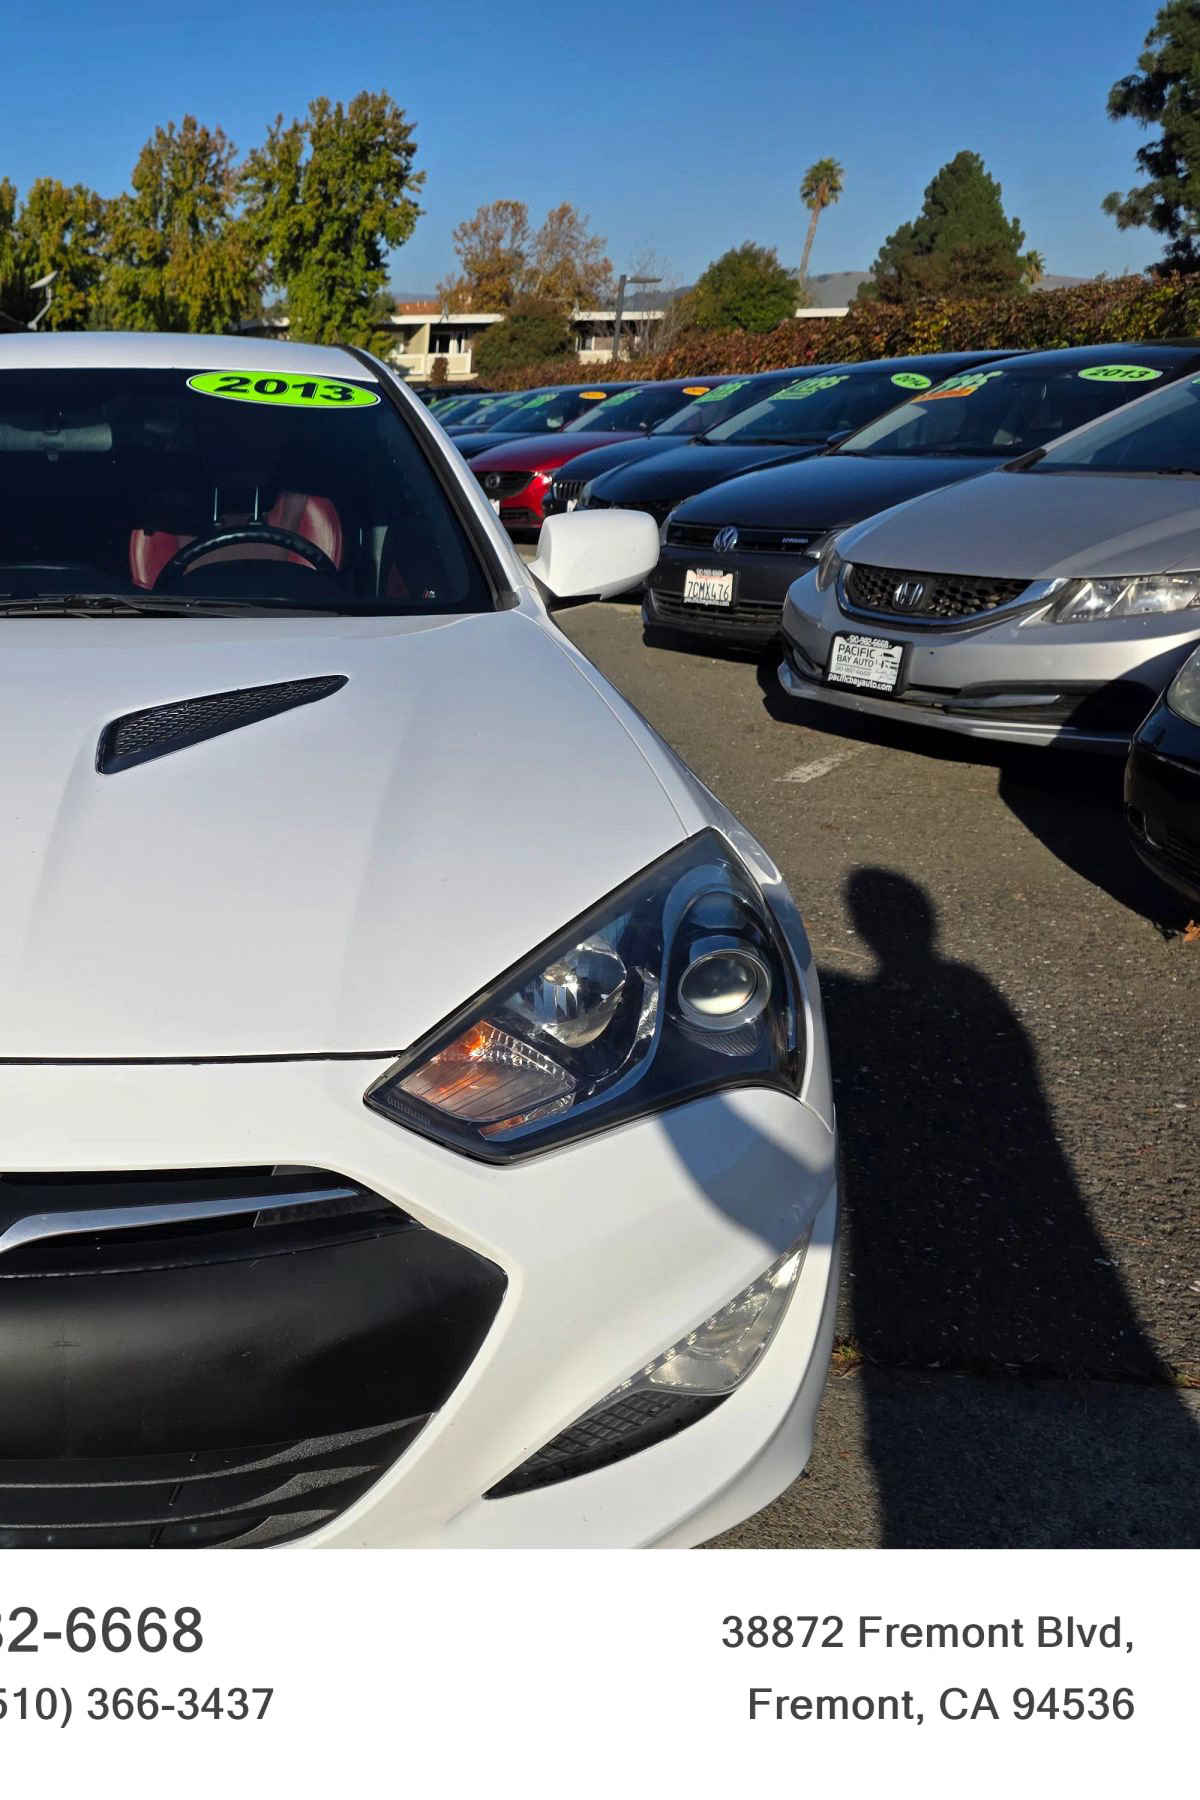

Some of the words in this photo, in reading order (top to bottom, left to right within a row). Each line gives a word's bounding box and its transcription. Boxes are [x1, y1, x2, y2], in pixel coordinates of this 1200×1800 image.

[213, 376, 356, 402] 2013
[838, 643, 876, 660] PACIFIC
[836, 655, 852, 664] BAY
[853, 657, 874, 668] AUTO
[827, 673, 893, 692] pacificbayauto.com
